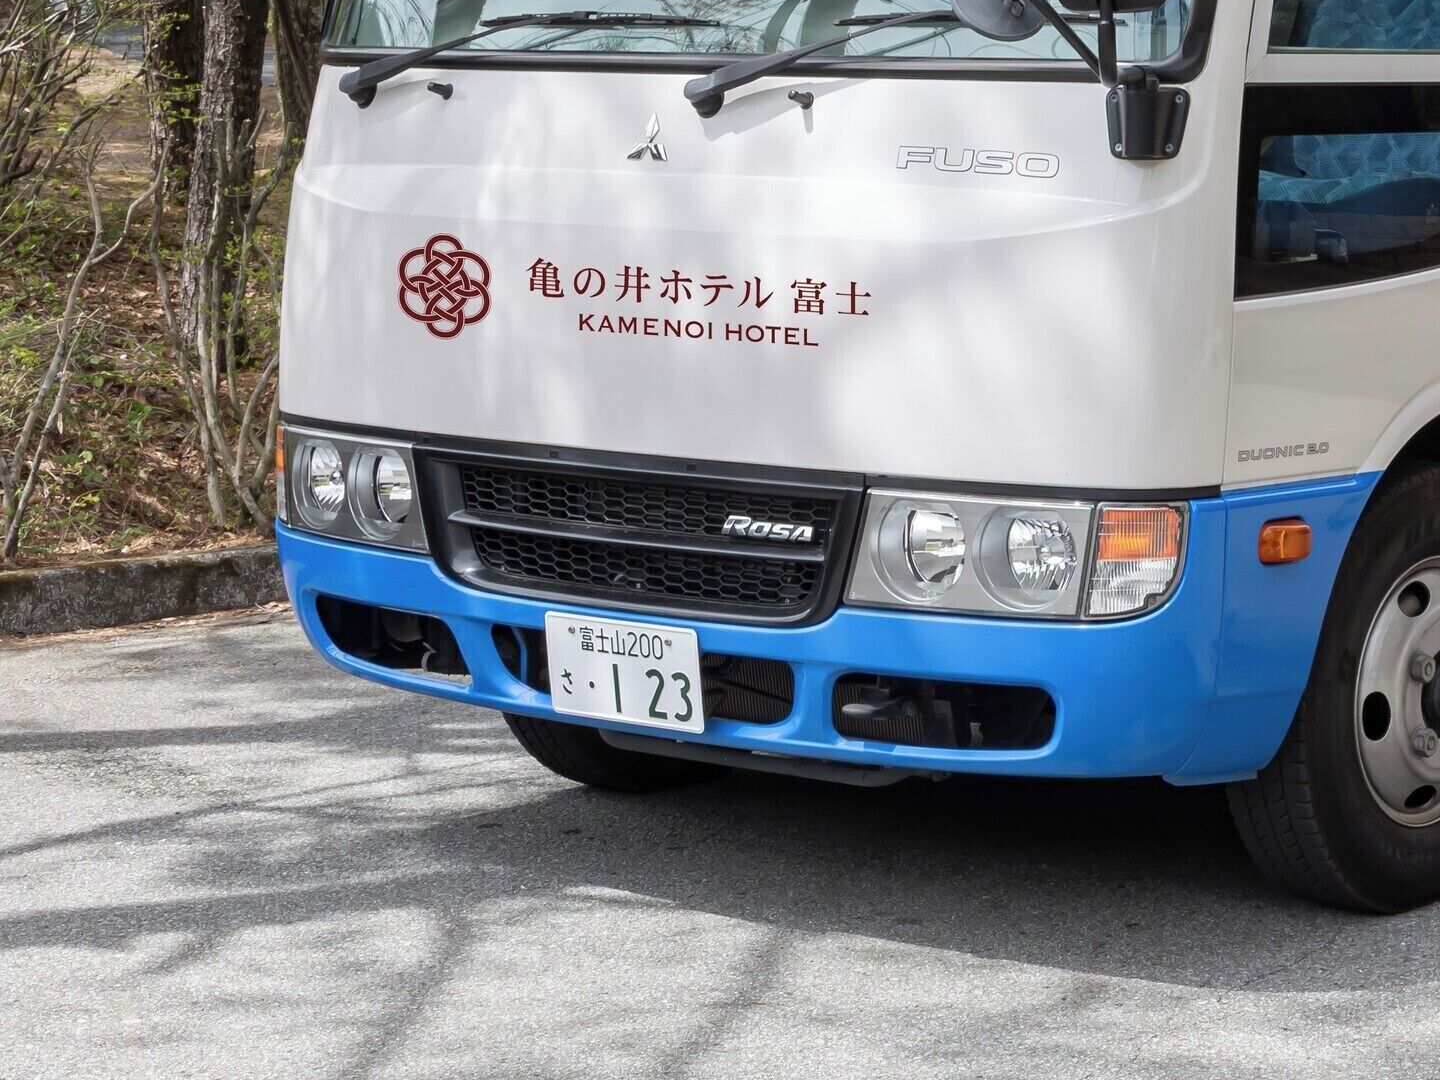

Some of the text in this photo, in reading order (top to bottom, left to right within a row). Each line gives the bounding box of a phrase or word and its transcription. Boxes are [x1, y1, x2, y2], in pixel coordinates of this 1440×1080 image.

[896, 145, 1060, 178] FUSO
[525, 257, 872, 316] 亀の井ホテル 富士
[578, 313, 820, 347] KAMENOI HOTEL
[1237, 443, 1305, 462] DUONIC
[721, 514, 815, 542] ROSA
[579, 626, 664, 660] 富士山200
